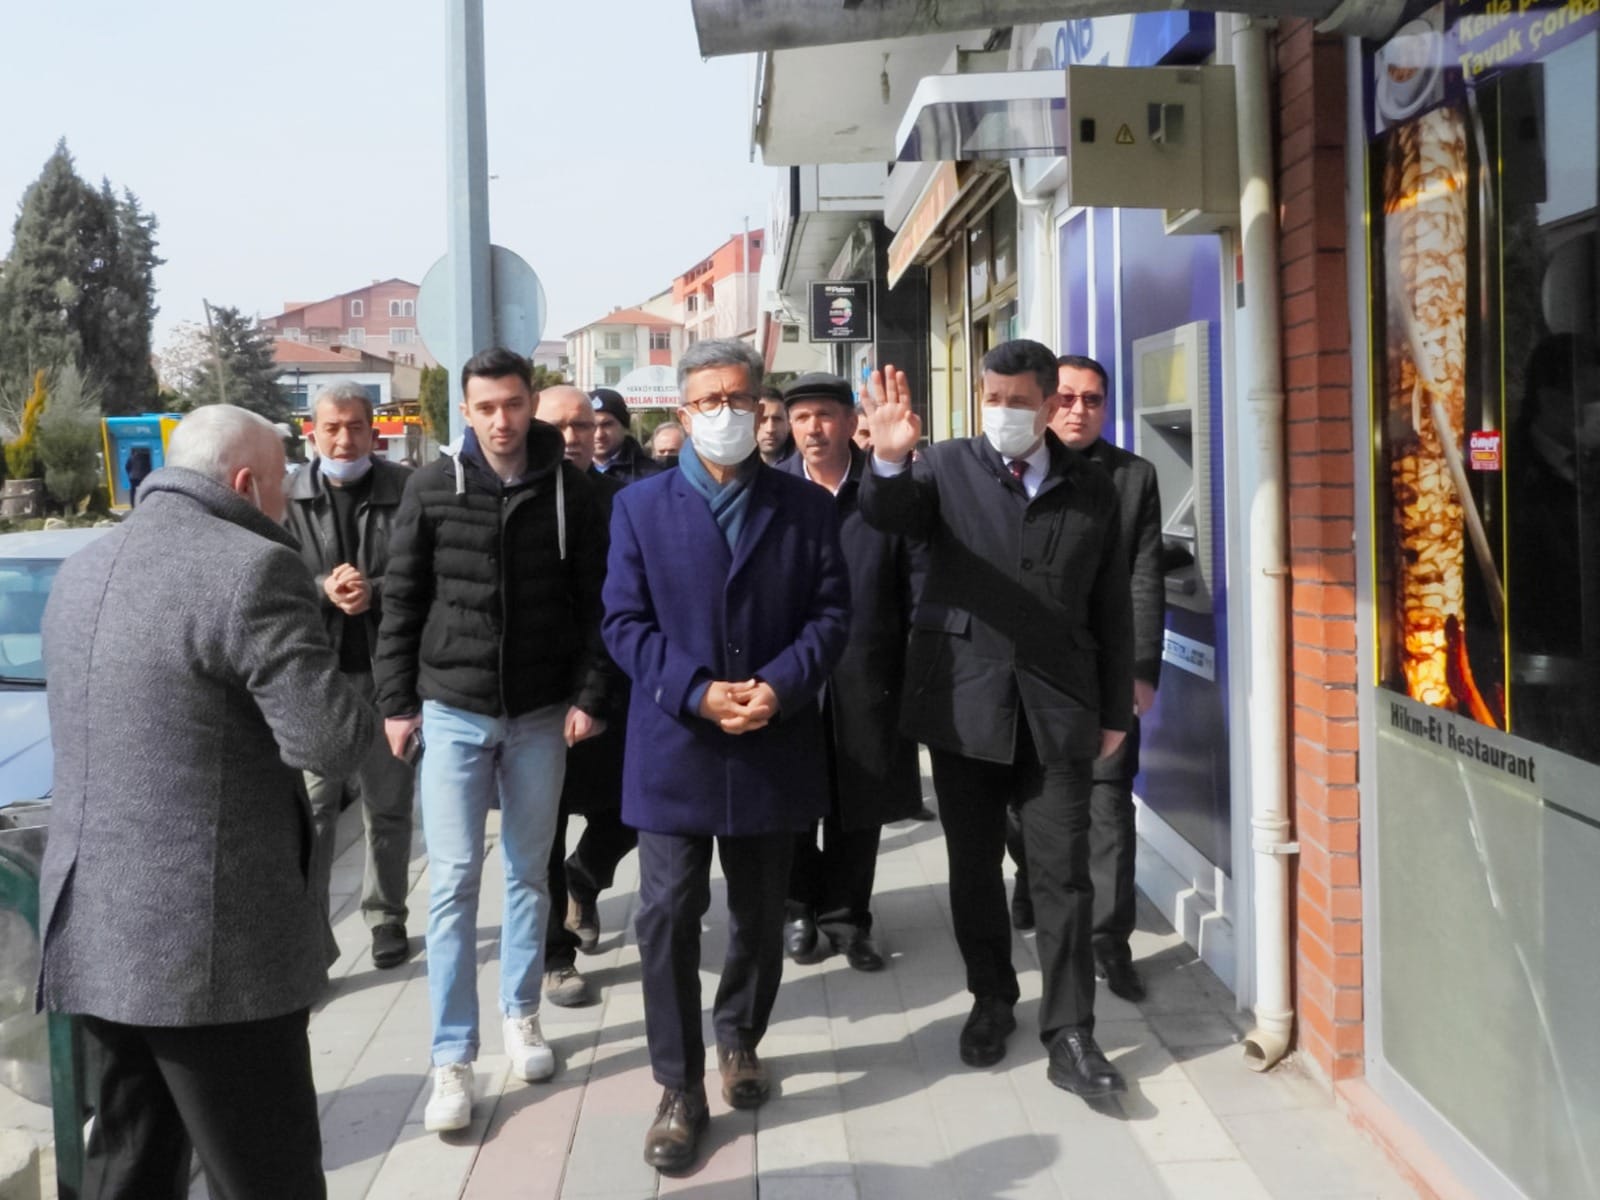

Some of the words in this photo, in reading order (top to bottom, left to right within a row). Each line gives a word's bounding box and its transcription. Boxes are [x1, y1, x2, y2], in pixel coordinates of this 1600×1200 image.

[1459, 29, 1522, 80] Tavuk
[1390, 702, 1443, 744] Hikm-Et
[1447, 722, 1536, 783] Restaurant
